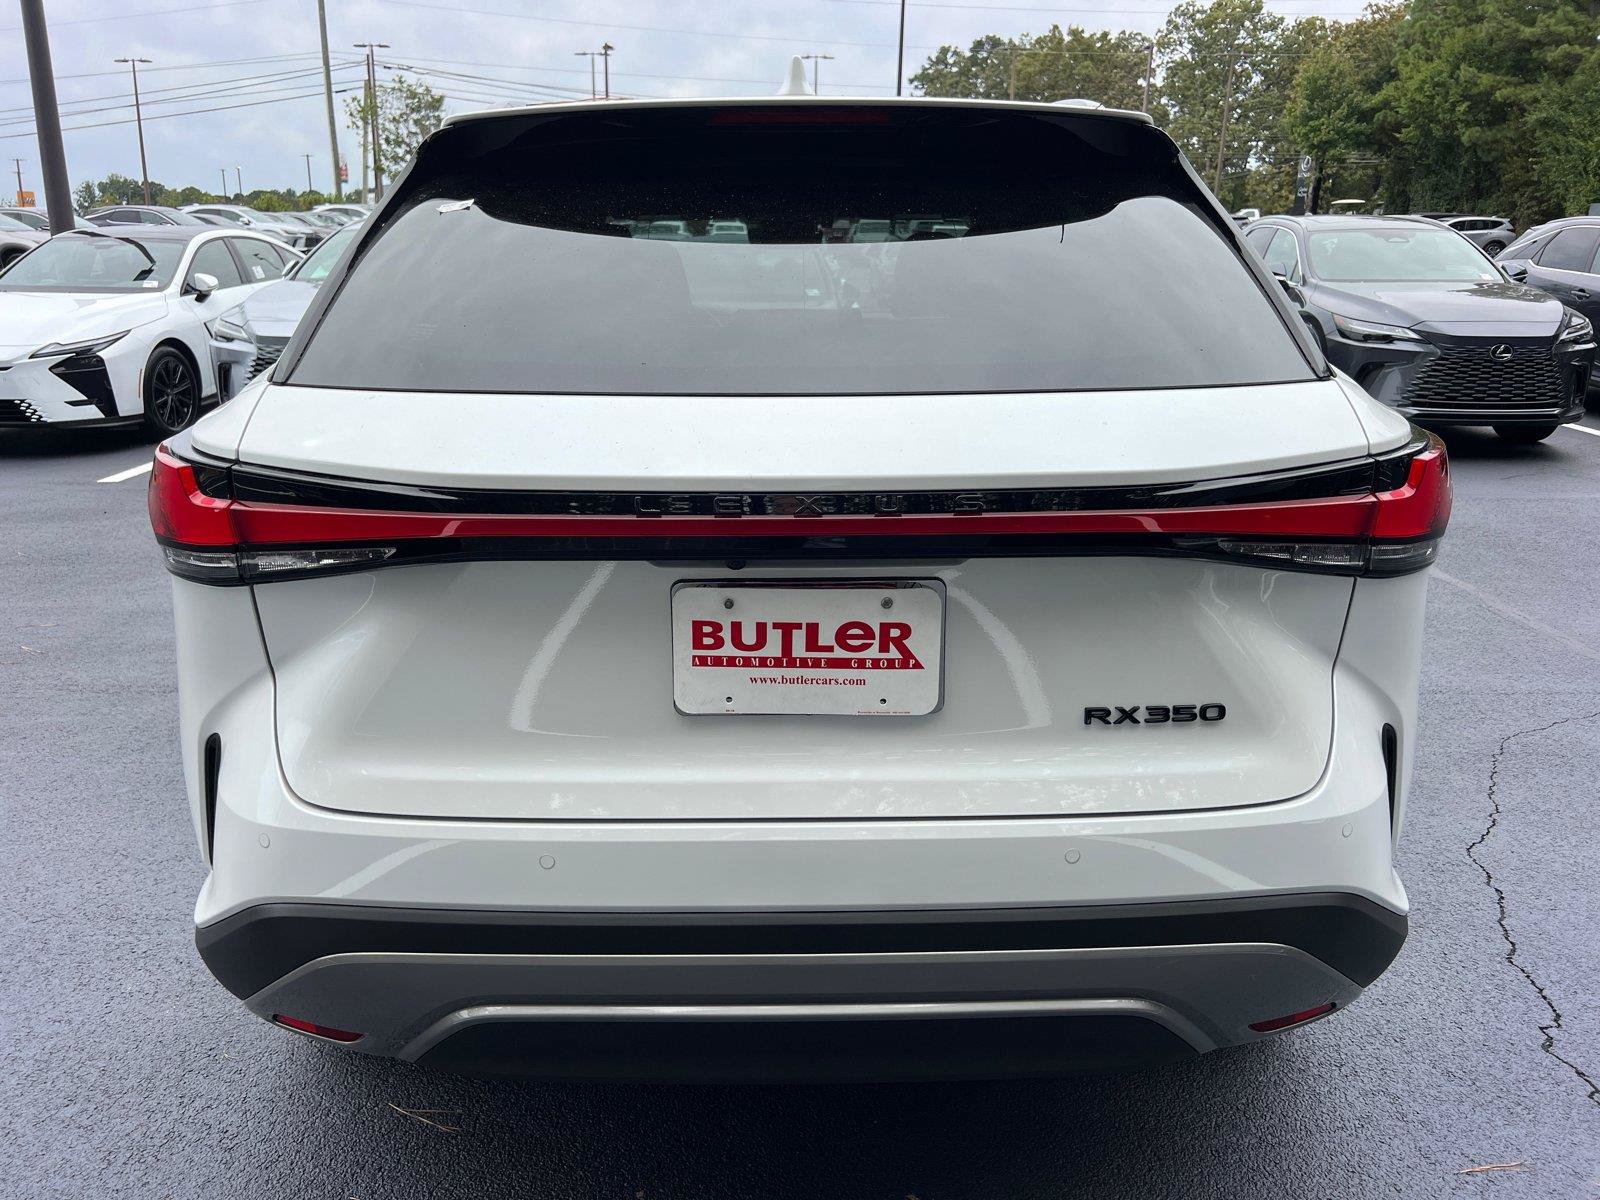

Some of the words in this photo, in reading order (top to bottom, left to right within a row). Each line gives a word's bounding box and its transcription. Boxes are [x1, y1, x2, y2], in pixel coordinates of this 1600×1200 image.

[634, 493, 984, 516] LEXUS
[693, 656, 828, 667] AUTOMOTIVE
[851, 659, 916, 669] GROUP
[750, 675, 866, 686] www.butlercars.com
